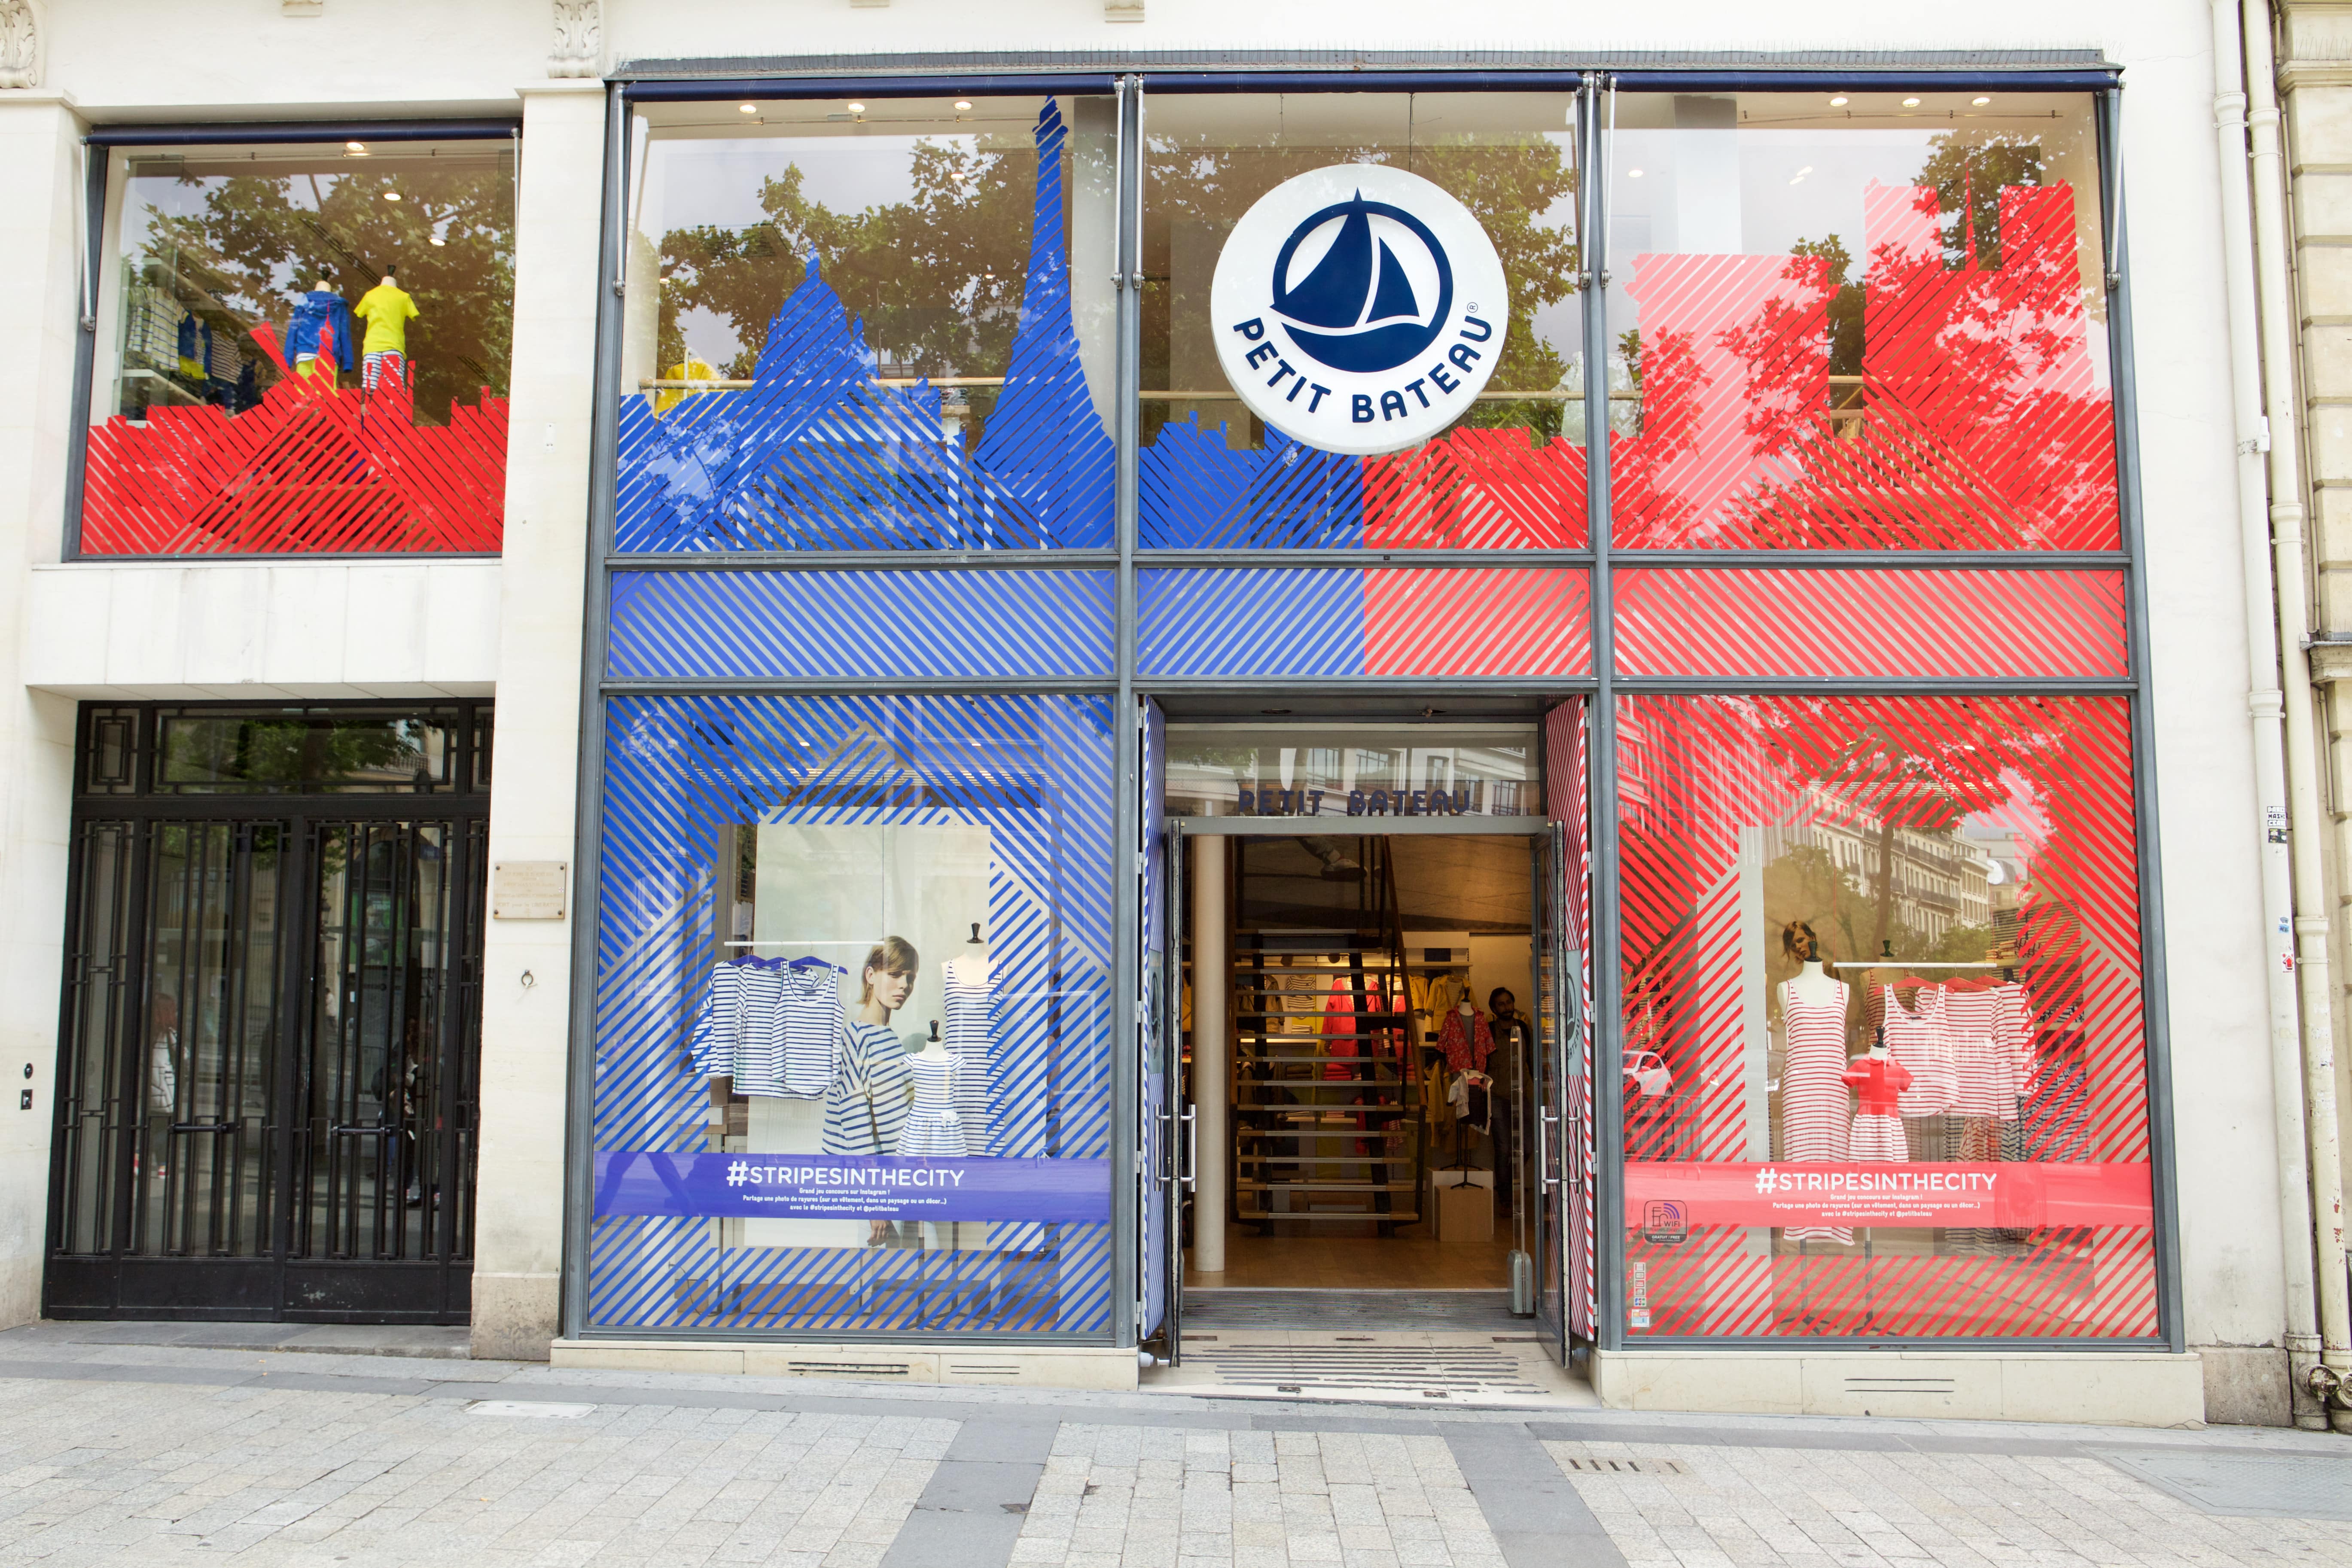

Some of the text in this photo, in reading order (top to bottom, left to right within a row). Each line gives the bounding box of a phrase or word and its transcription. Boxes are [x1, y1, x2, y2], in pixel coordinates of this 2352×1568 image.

[1233, 317, 1331, 413] PETIT
[1239, 790, 1470, 812] PETIT BATEAU
[726, 1161, 965, 1187] #STRIPESINTHECITY
[1755, 1168, 1997, 1194] #STRIPESINTHECITY
